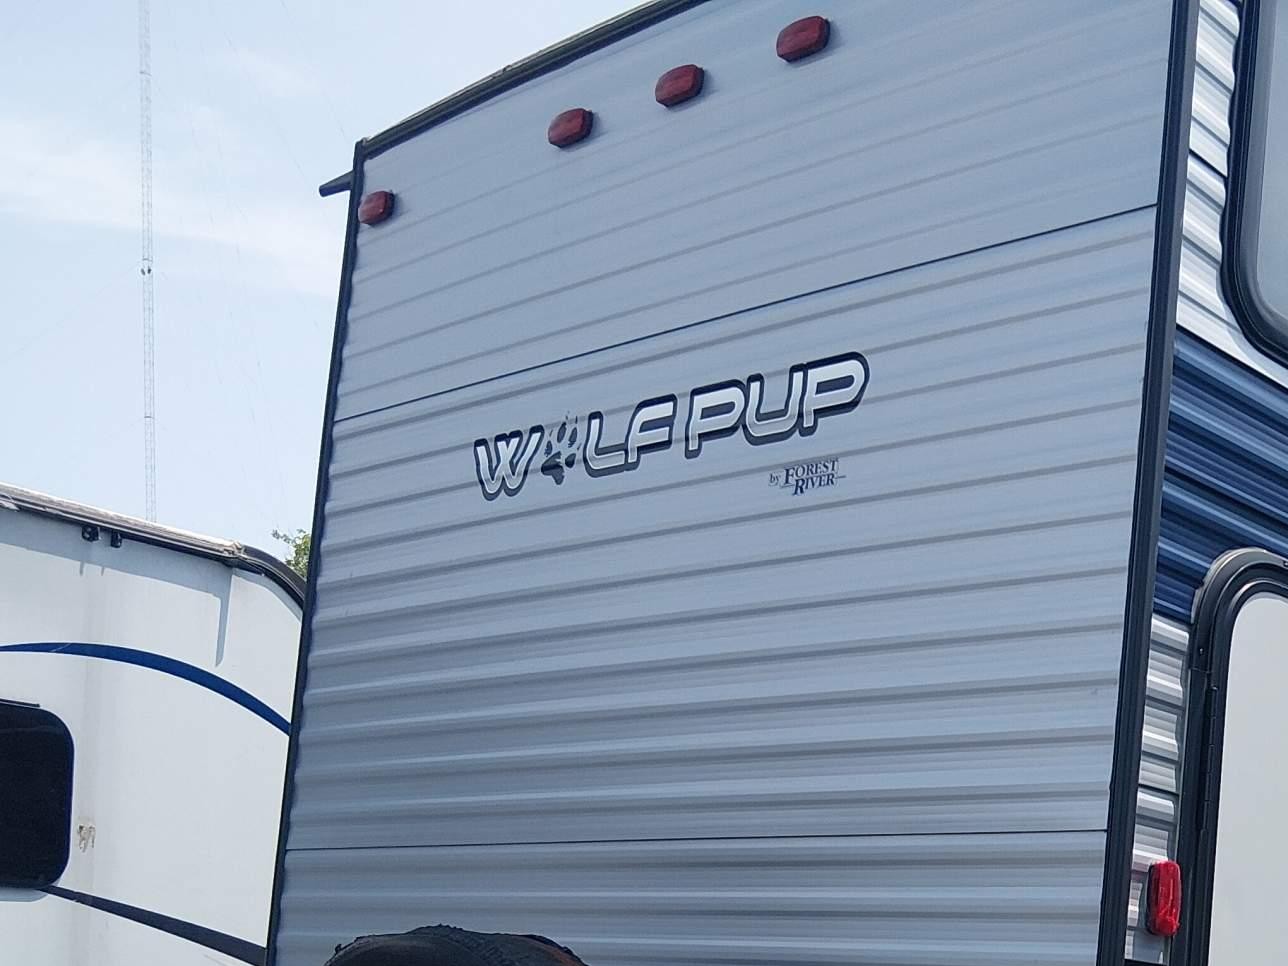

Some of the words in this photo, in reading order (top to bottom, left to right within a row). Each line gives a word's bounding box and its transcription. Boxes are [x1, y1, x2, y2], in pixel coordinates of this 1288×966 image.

[684, 352, 869, 457] PUP
[784, 458, 838, 485] FOREST
[793, 473, 835, 496] RIVER
